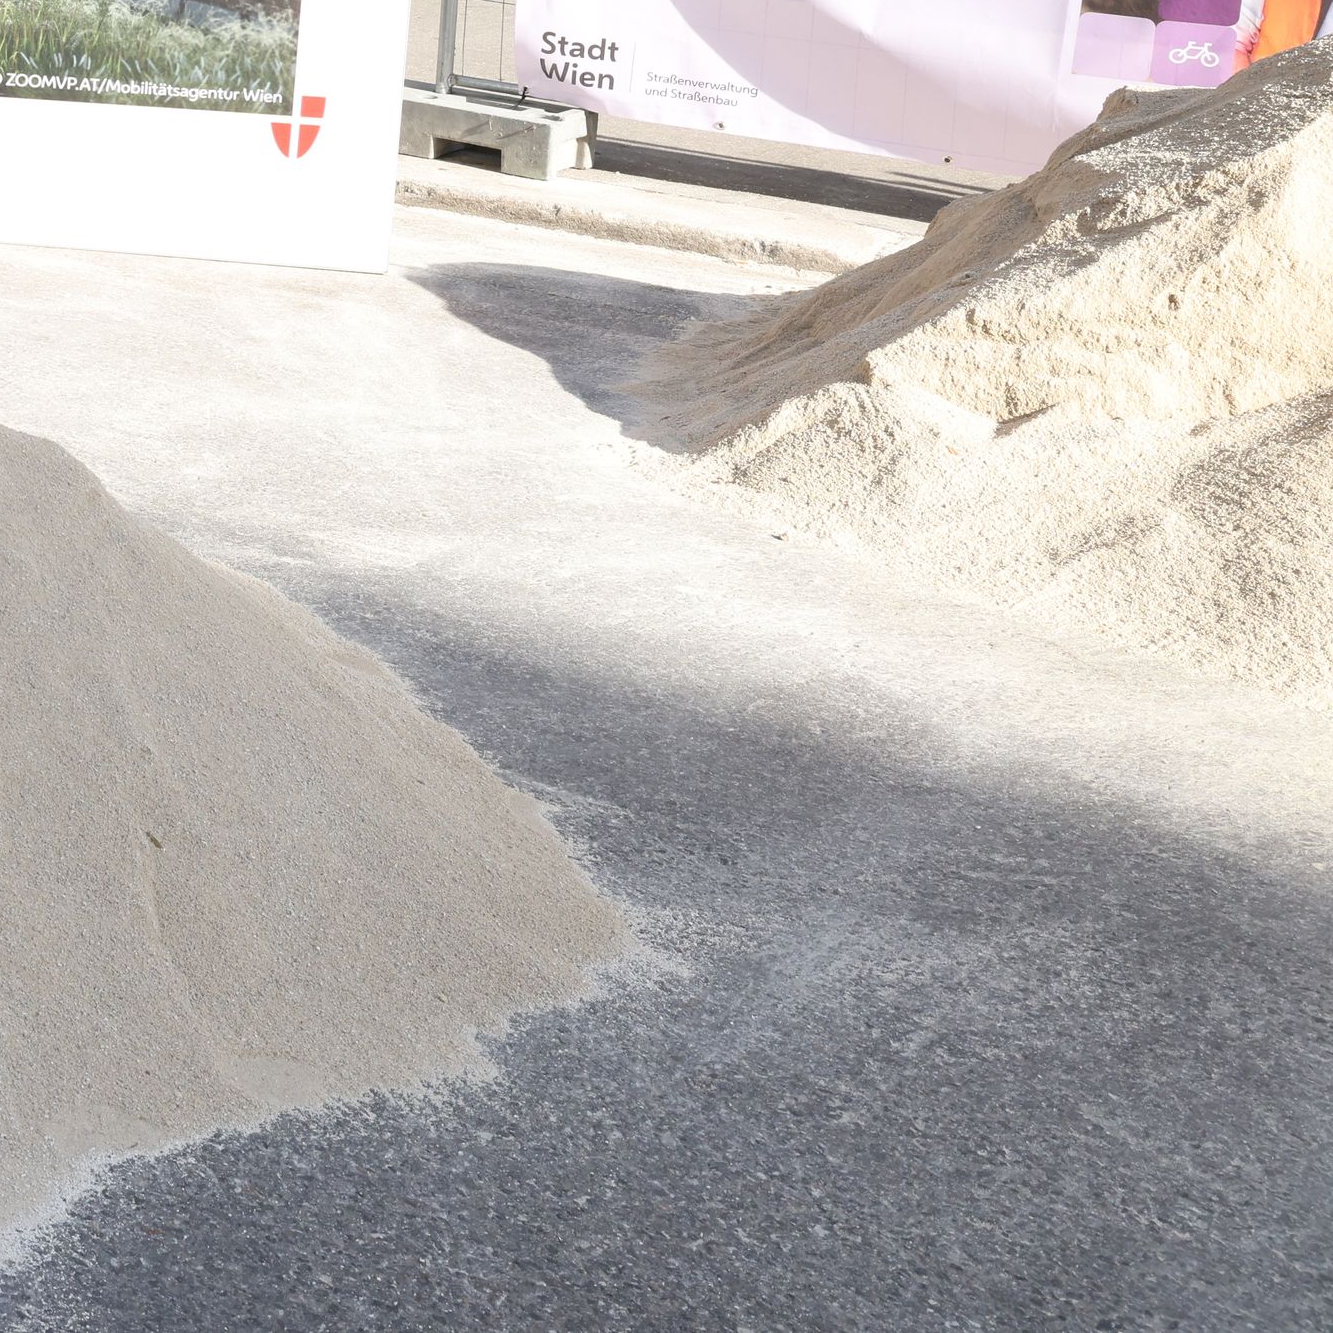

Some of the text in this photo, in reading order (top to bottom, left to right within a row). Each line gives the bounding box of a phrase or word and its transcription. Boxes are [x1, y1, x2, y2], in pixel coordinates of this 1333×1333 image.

[540, 31, 619, 63] Stadt
[5, 72, 240, 102] ZOOMVP.AT/Mobilitätsagentur
[242, 87, 283, 105] Wien
[539, 58, 615, 91] Wien
[646, 71, 758, 98] Straßenverwaltung
[644, 87, 738, 107] und Straßenbau
